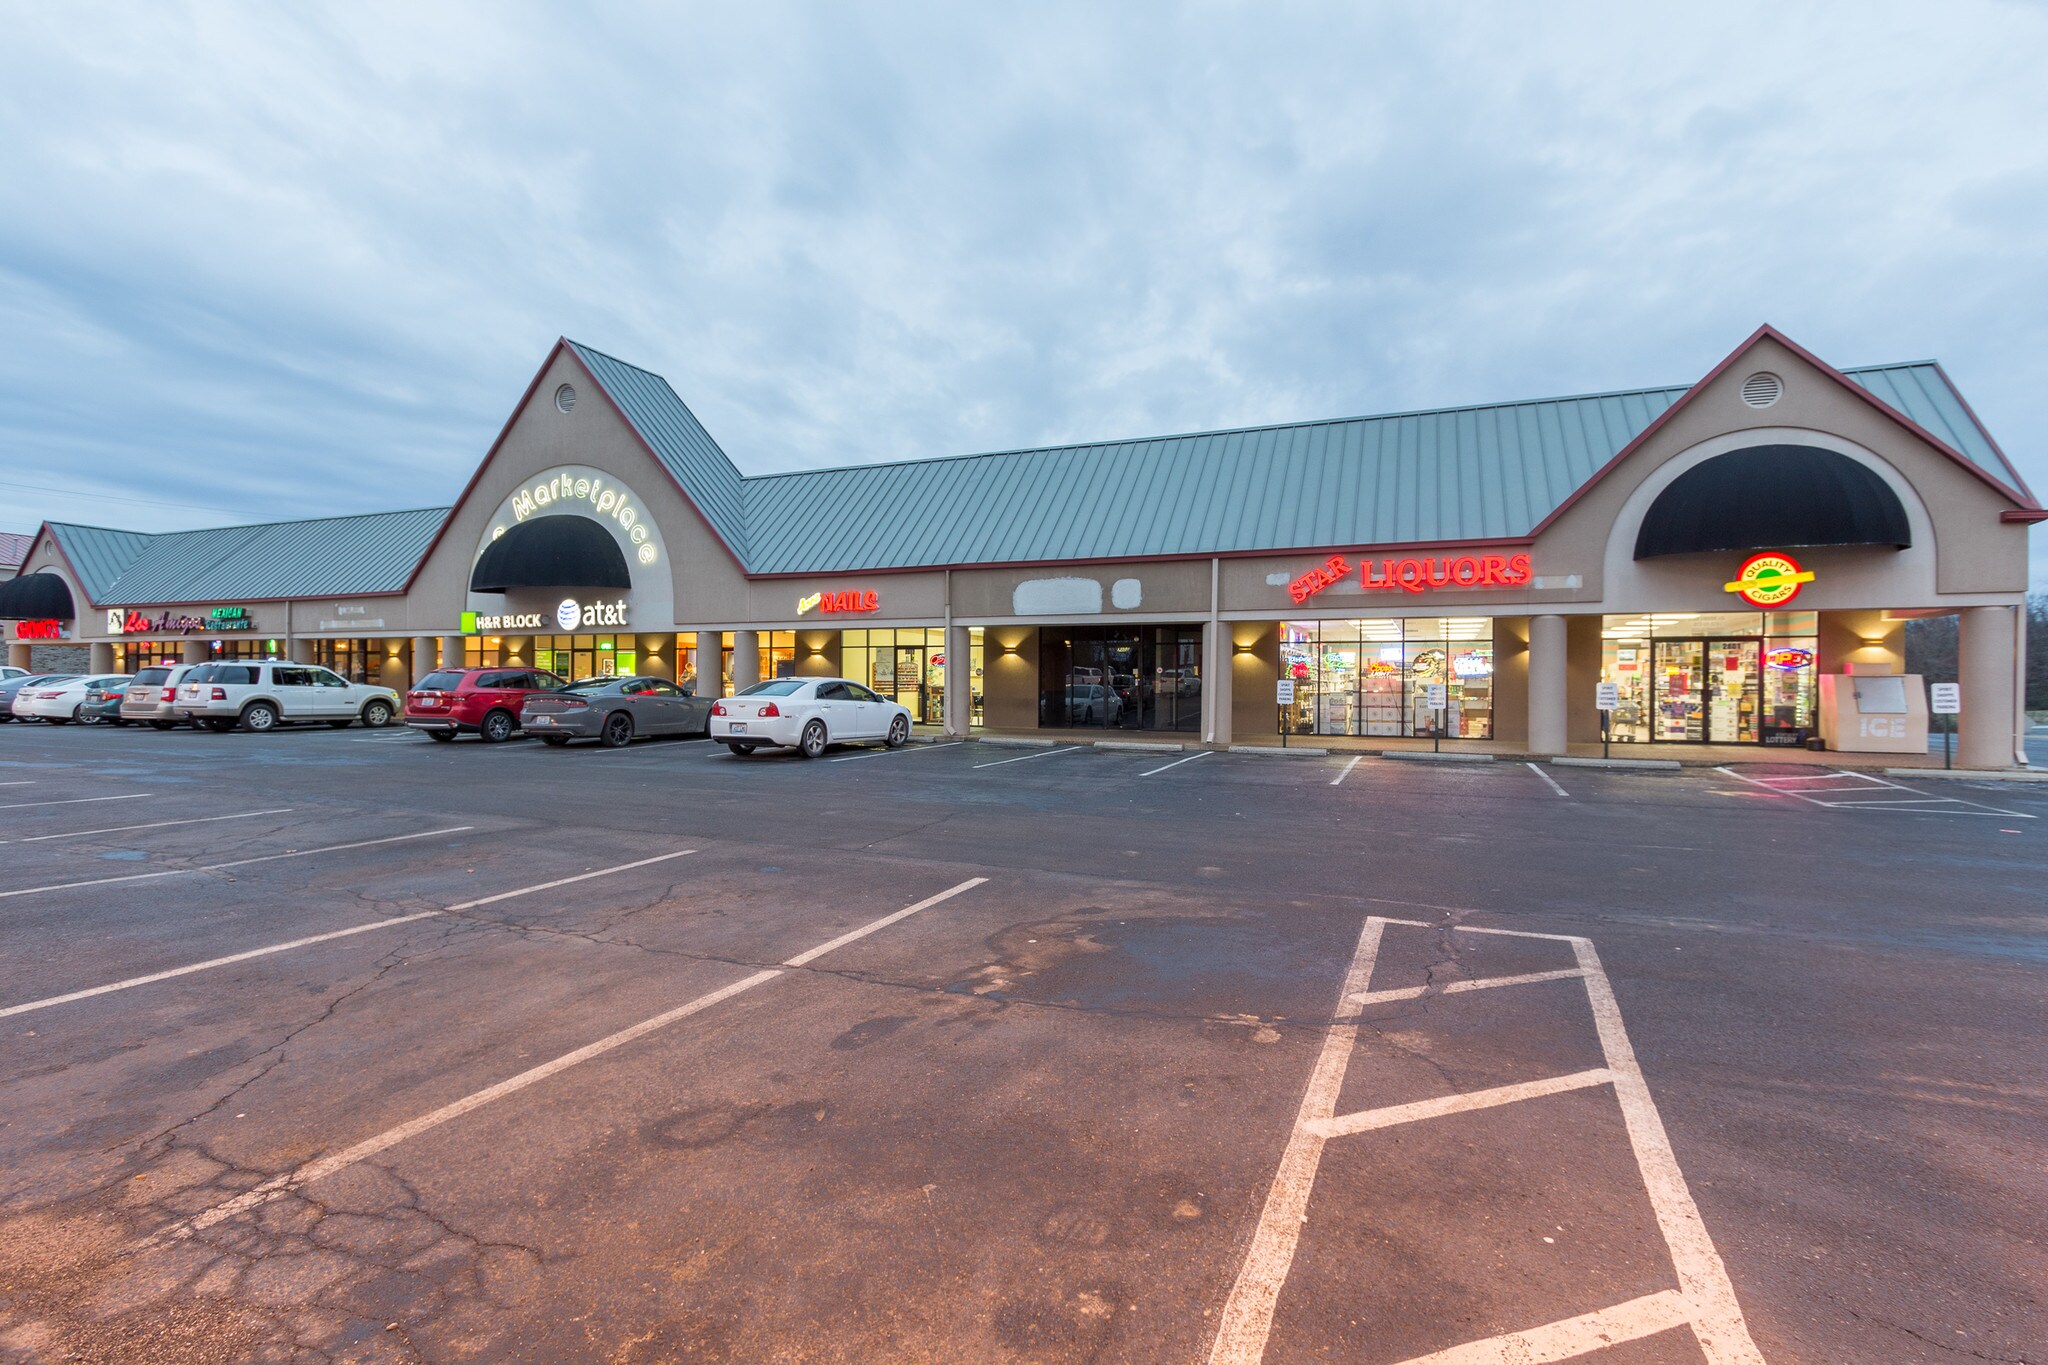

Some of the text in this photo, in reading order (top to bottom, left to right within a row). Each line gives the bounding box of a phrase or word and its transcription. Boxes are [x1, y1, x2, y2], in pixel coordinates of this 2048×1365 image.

[512, 473, 655, 564] Marketplace
[1746, 560, 1791, 578] QUALITY
[1288, 554, 1532, 604] STAR LIQUORS
[820, 590, 879, 613] NAILS
[1751, 586, 1791, 602] CIGARS
[124, 609, 206, 635] Los Amigos
[211, 607, 243, 619] MEXICAN
[476, 613, 542, 630] H&R BLOCK
[582, 600, 627, 626] at&t
[1765, 652, 1813, 666] OPEN
[1860, 717, 1906, 738] ICE
[1765, 736, 1798, 744] LOTTERY
